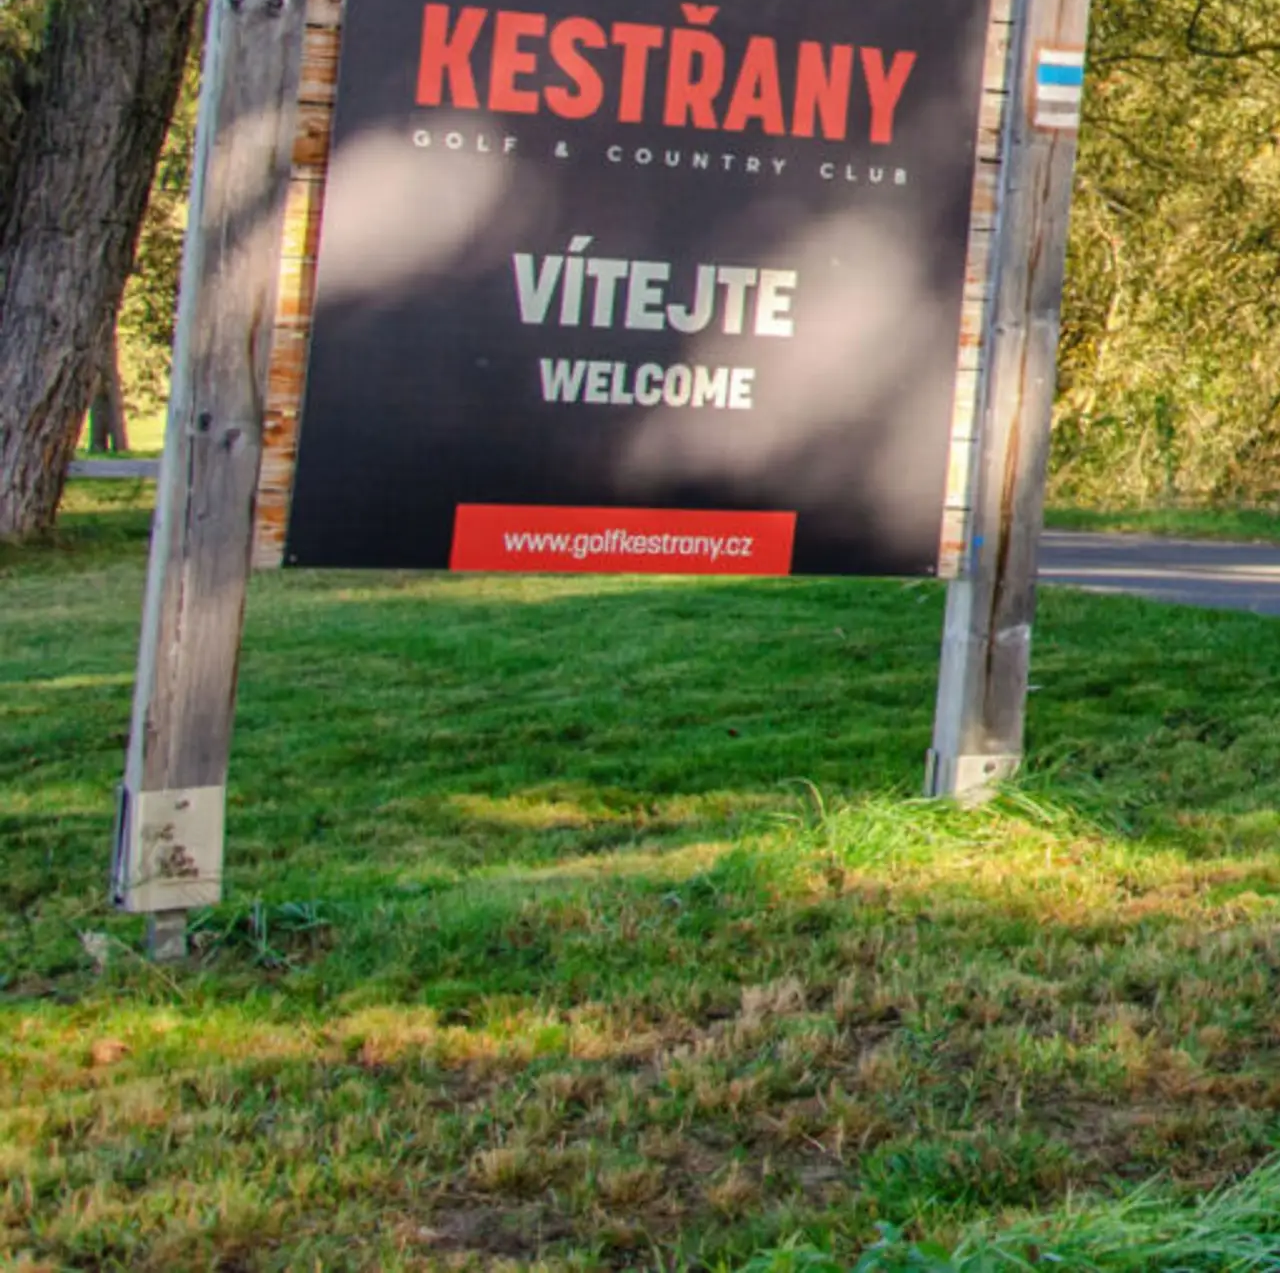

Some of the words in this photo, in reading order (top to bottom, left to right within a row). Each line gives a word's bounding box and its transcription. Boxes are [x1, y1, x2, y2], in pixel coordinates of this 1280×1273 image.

[415, 2, 917, 145] KESTŘANY
[413, 130, 517, 153] GOLF
[554, 140, 569, 158] &
[606, 145, 787, 175] COUNTRY
[820, 163, 907, 185] CLUB
[513, 235, 798, 337] VÍTEJTE
[540, 358, 755, 409] WELCOME
[504, 529, 752, 561] www.golfkestrany.cz
